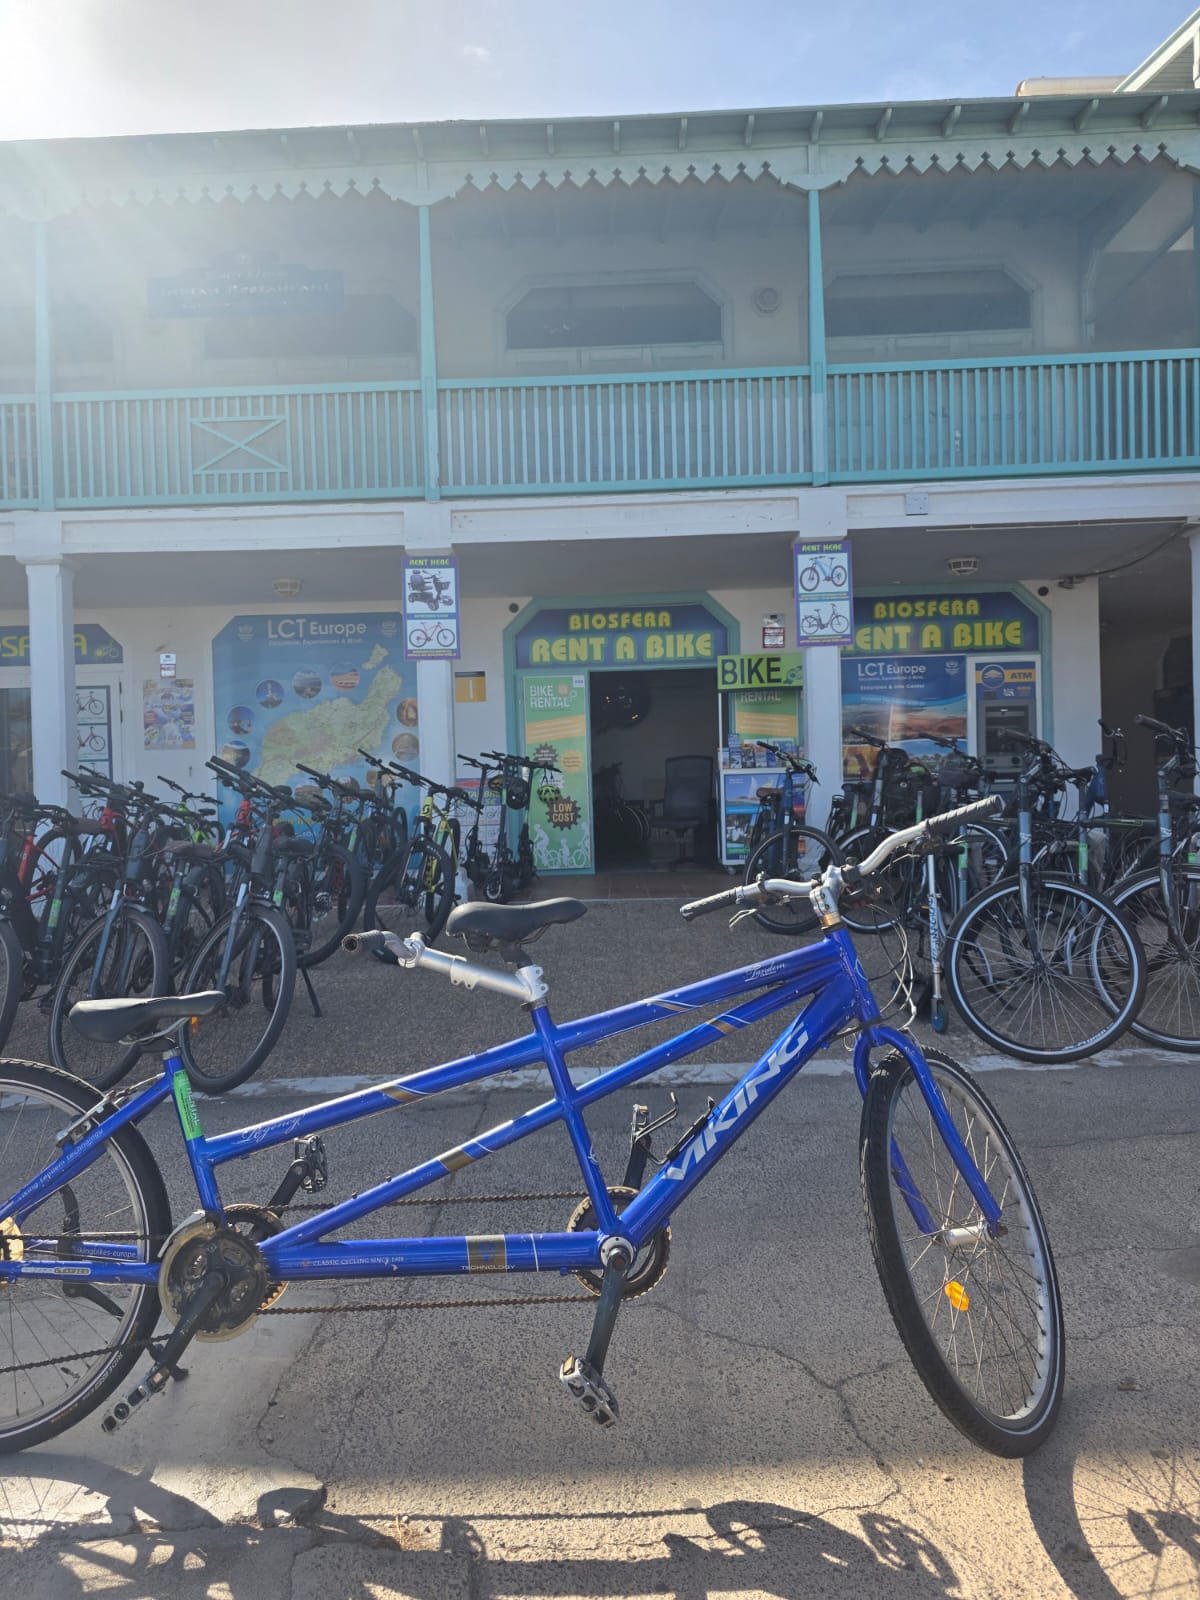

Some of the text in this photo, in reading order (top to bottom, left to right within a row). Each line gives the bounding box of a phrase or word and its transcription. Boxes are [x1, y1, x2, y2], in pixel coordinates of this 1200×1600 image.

[874, 599, 980, 619] BIOSFERA
[267, 619, 368, 639] LCT Europe
[568, 611, 672, 631] BIOSFERA
[840, 621, 1022, 652] ENT A BIKE
[532, 633, 713, 663] RENT A BIKE
[721, 657, 783, 686] BIKE
[857, 662, 927, 677] LCT Europe
[1010, 672, 1033, 680] ATM
[529, 685, 554, 697] BIKE
[740, 690, 782, 704] RENTAL
[530, 696, 571, 709] RENTAL
[553, 803, 573, 813] LOW
[552, 813, 574, 823] COST
[663, 1022, 809, 1181] VIKING
